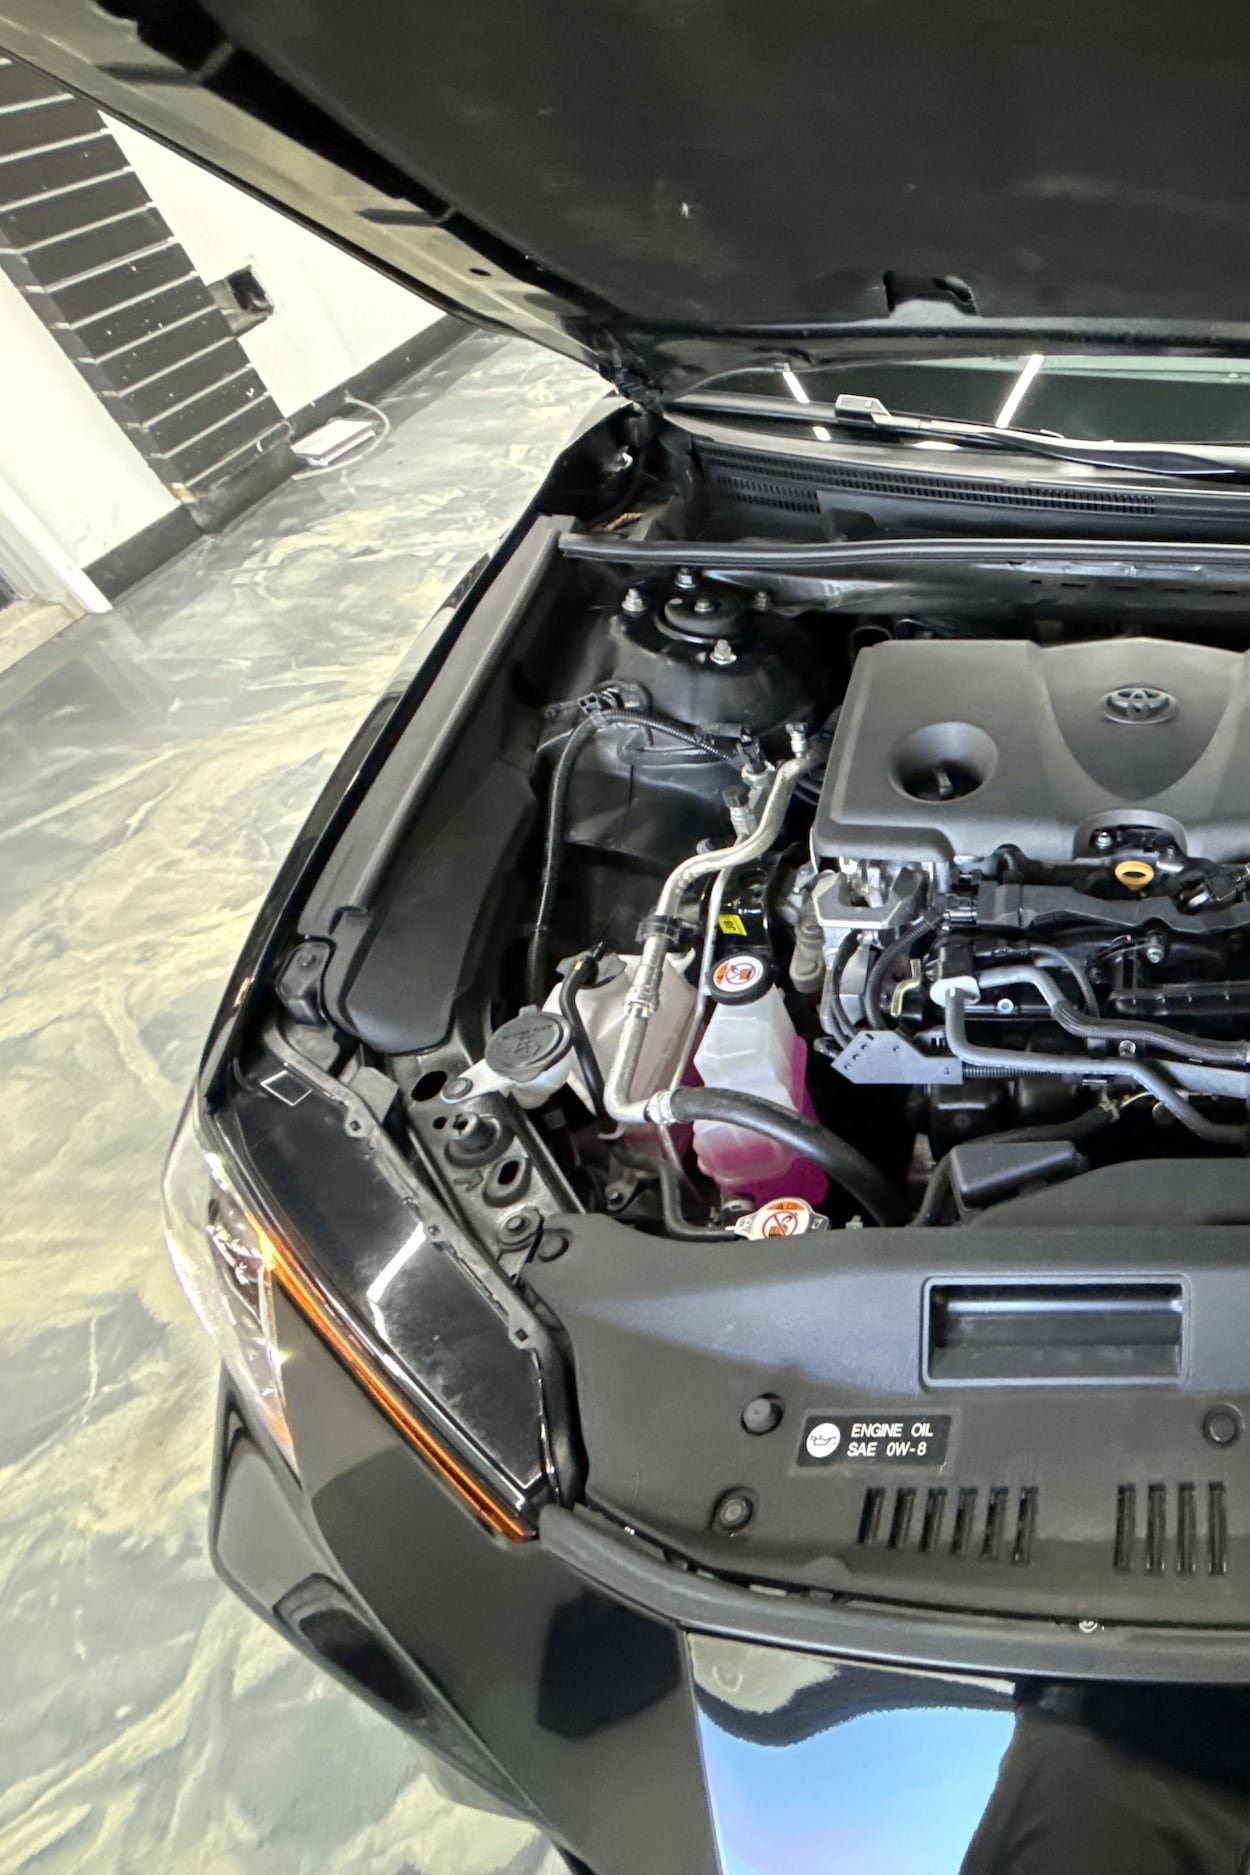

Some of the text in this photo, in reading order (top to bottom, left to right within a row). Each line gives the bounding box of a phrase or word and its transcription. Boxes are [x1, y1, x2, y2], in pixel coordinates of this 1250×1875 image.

[851, 1423, 934, 1438] ENGINE OIL
[847, 1441, 927, 1457] SAE 0W-8
